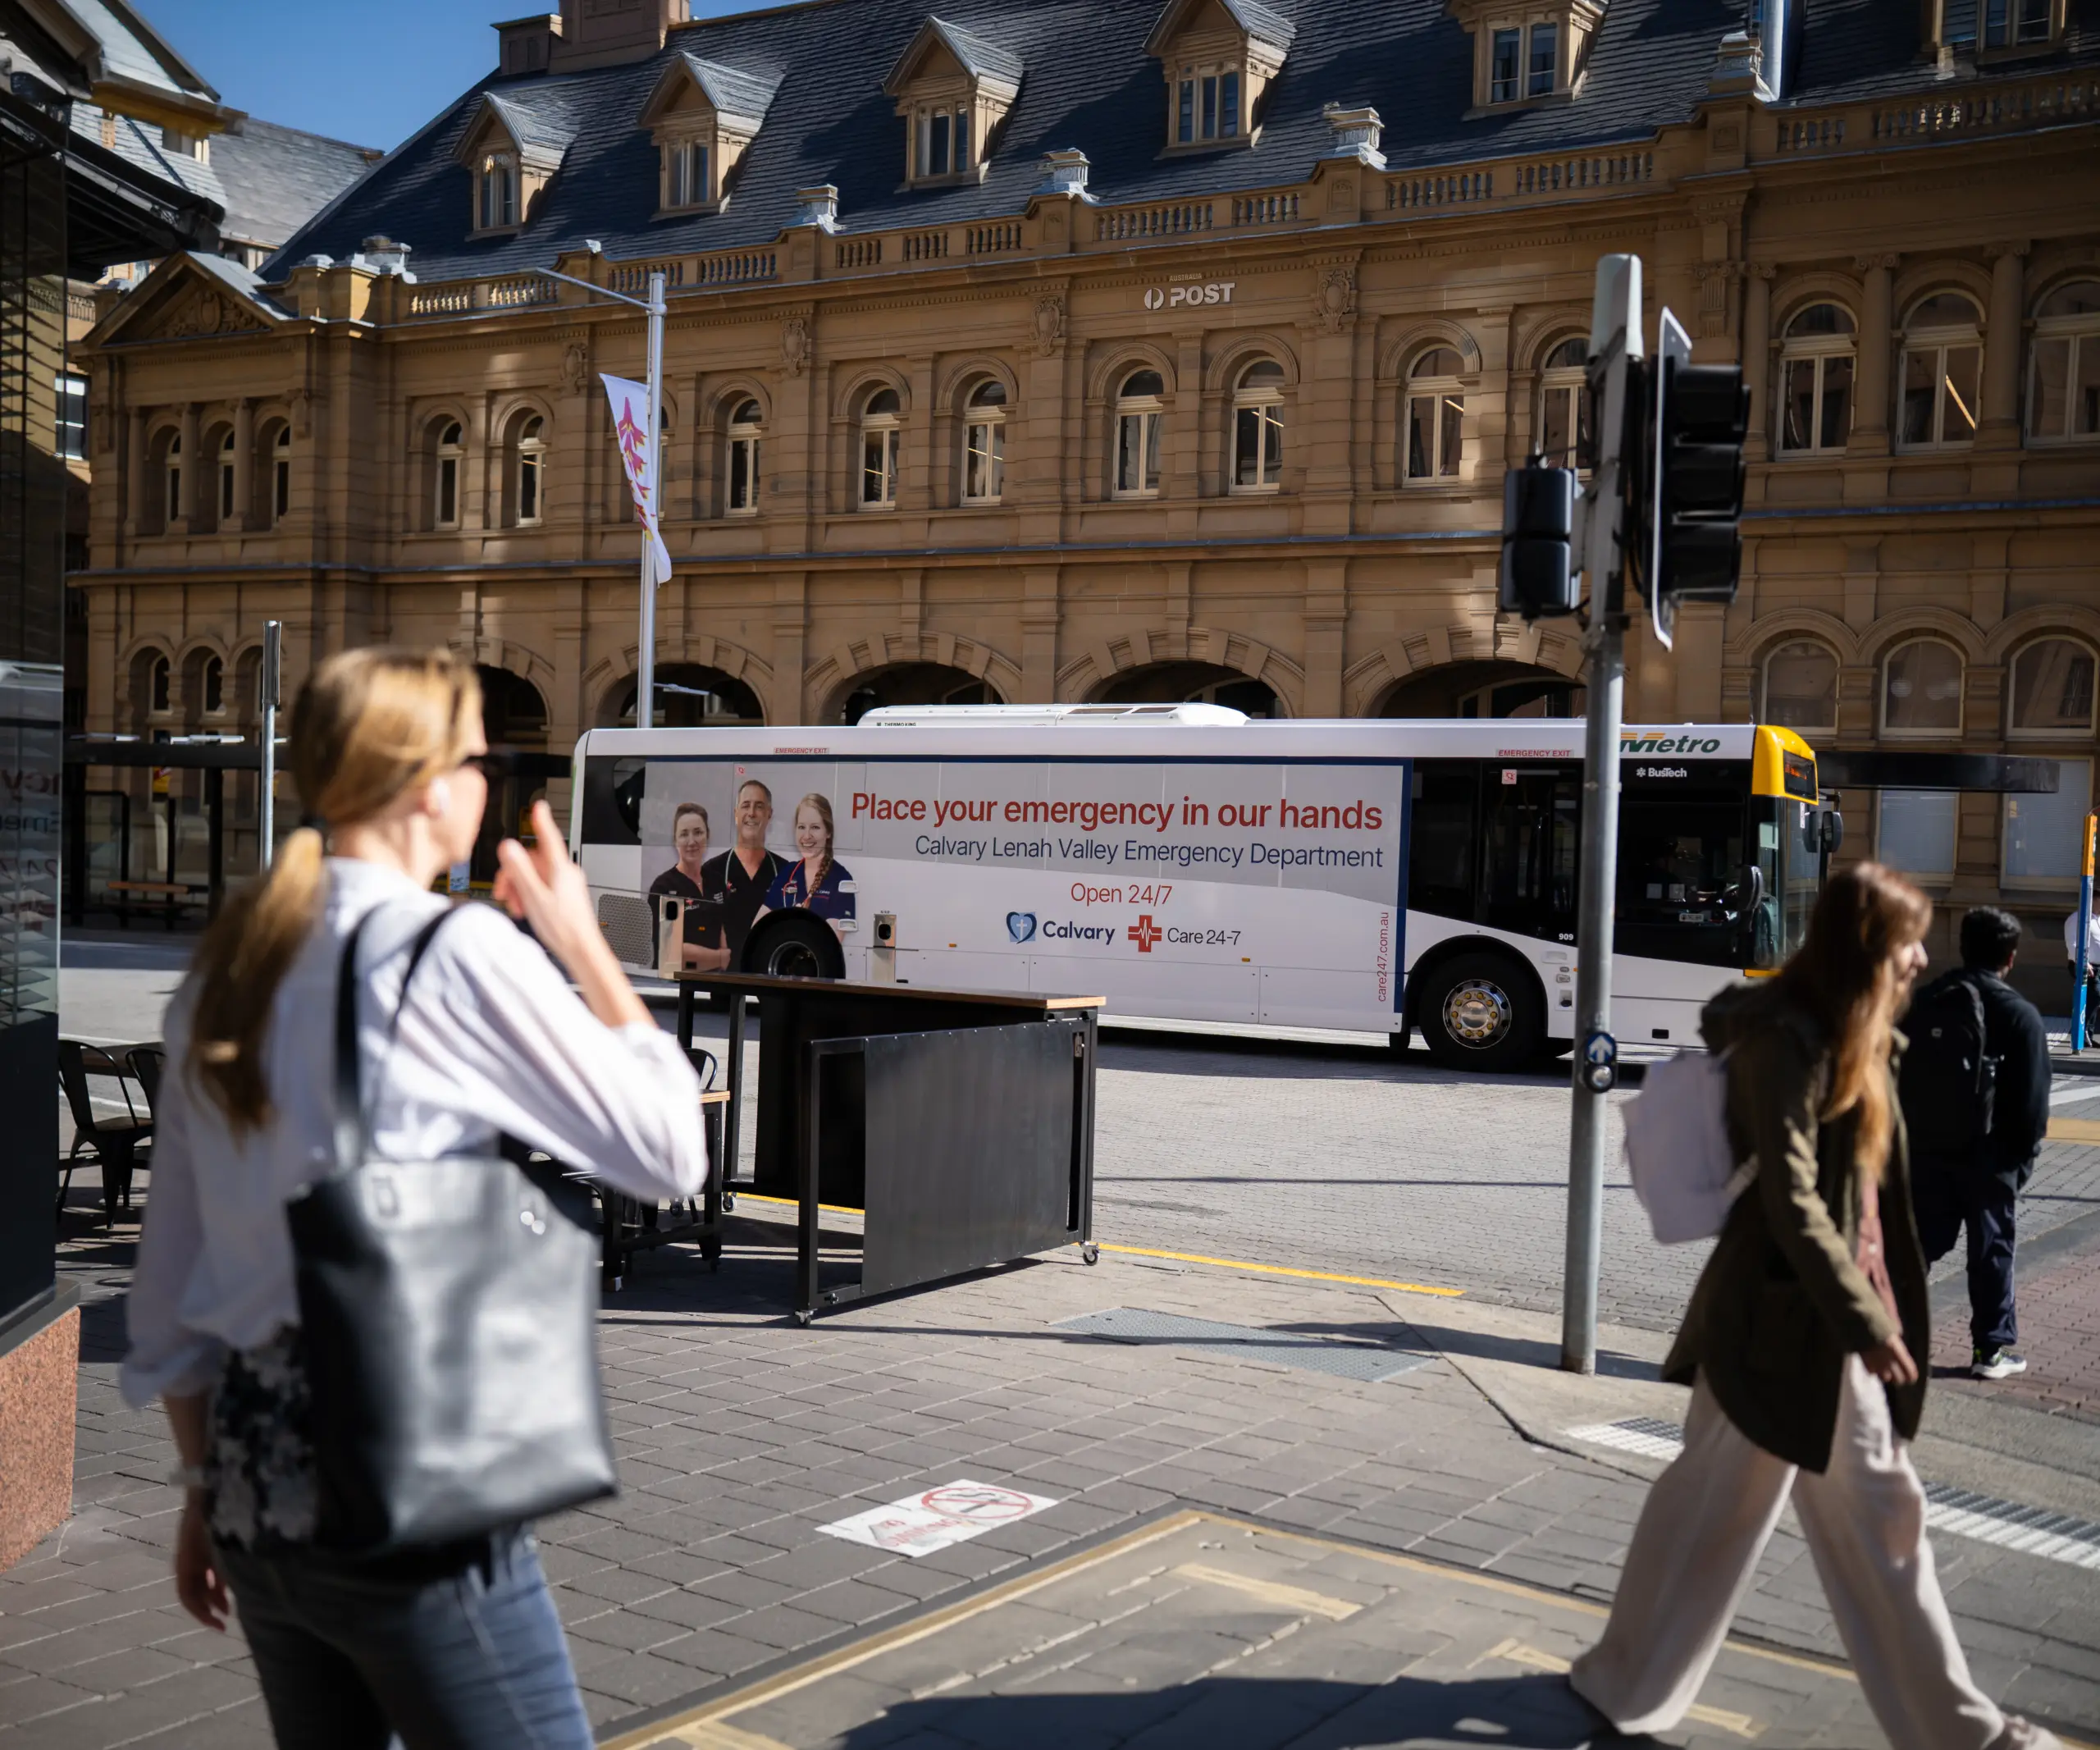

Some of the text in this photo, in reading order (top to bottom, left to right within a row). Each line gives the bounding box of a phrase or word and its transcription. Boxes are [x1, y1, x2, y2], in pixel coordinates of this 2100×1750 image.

[1169, 273, 1203, 281] AUSTRALIA
[1170, 282, 1235, 308] POST
[1648, 767, 1687, 778] BusTech
[851, 793, 1382, 833] Place your emergency in our hands
[915, 835, 1384, 870] Calvary Lenah Valley Emergency Department
[1071, 882, 1173, 906] Open 24/7
[1043, 920, 1116, 946] Calvary
[1377, 912, 1389, 1002] care247.com.au
